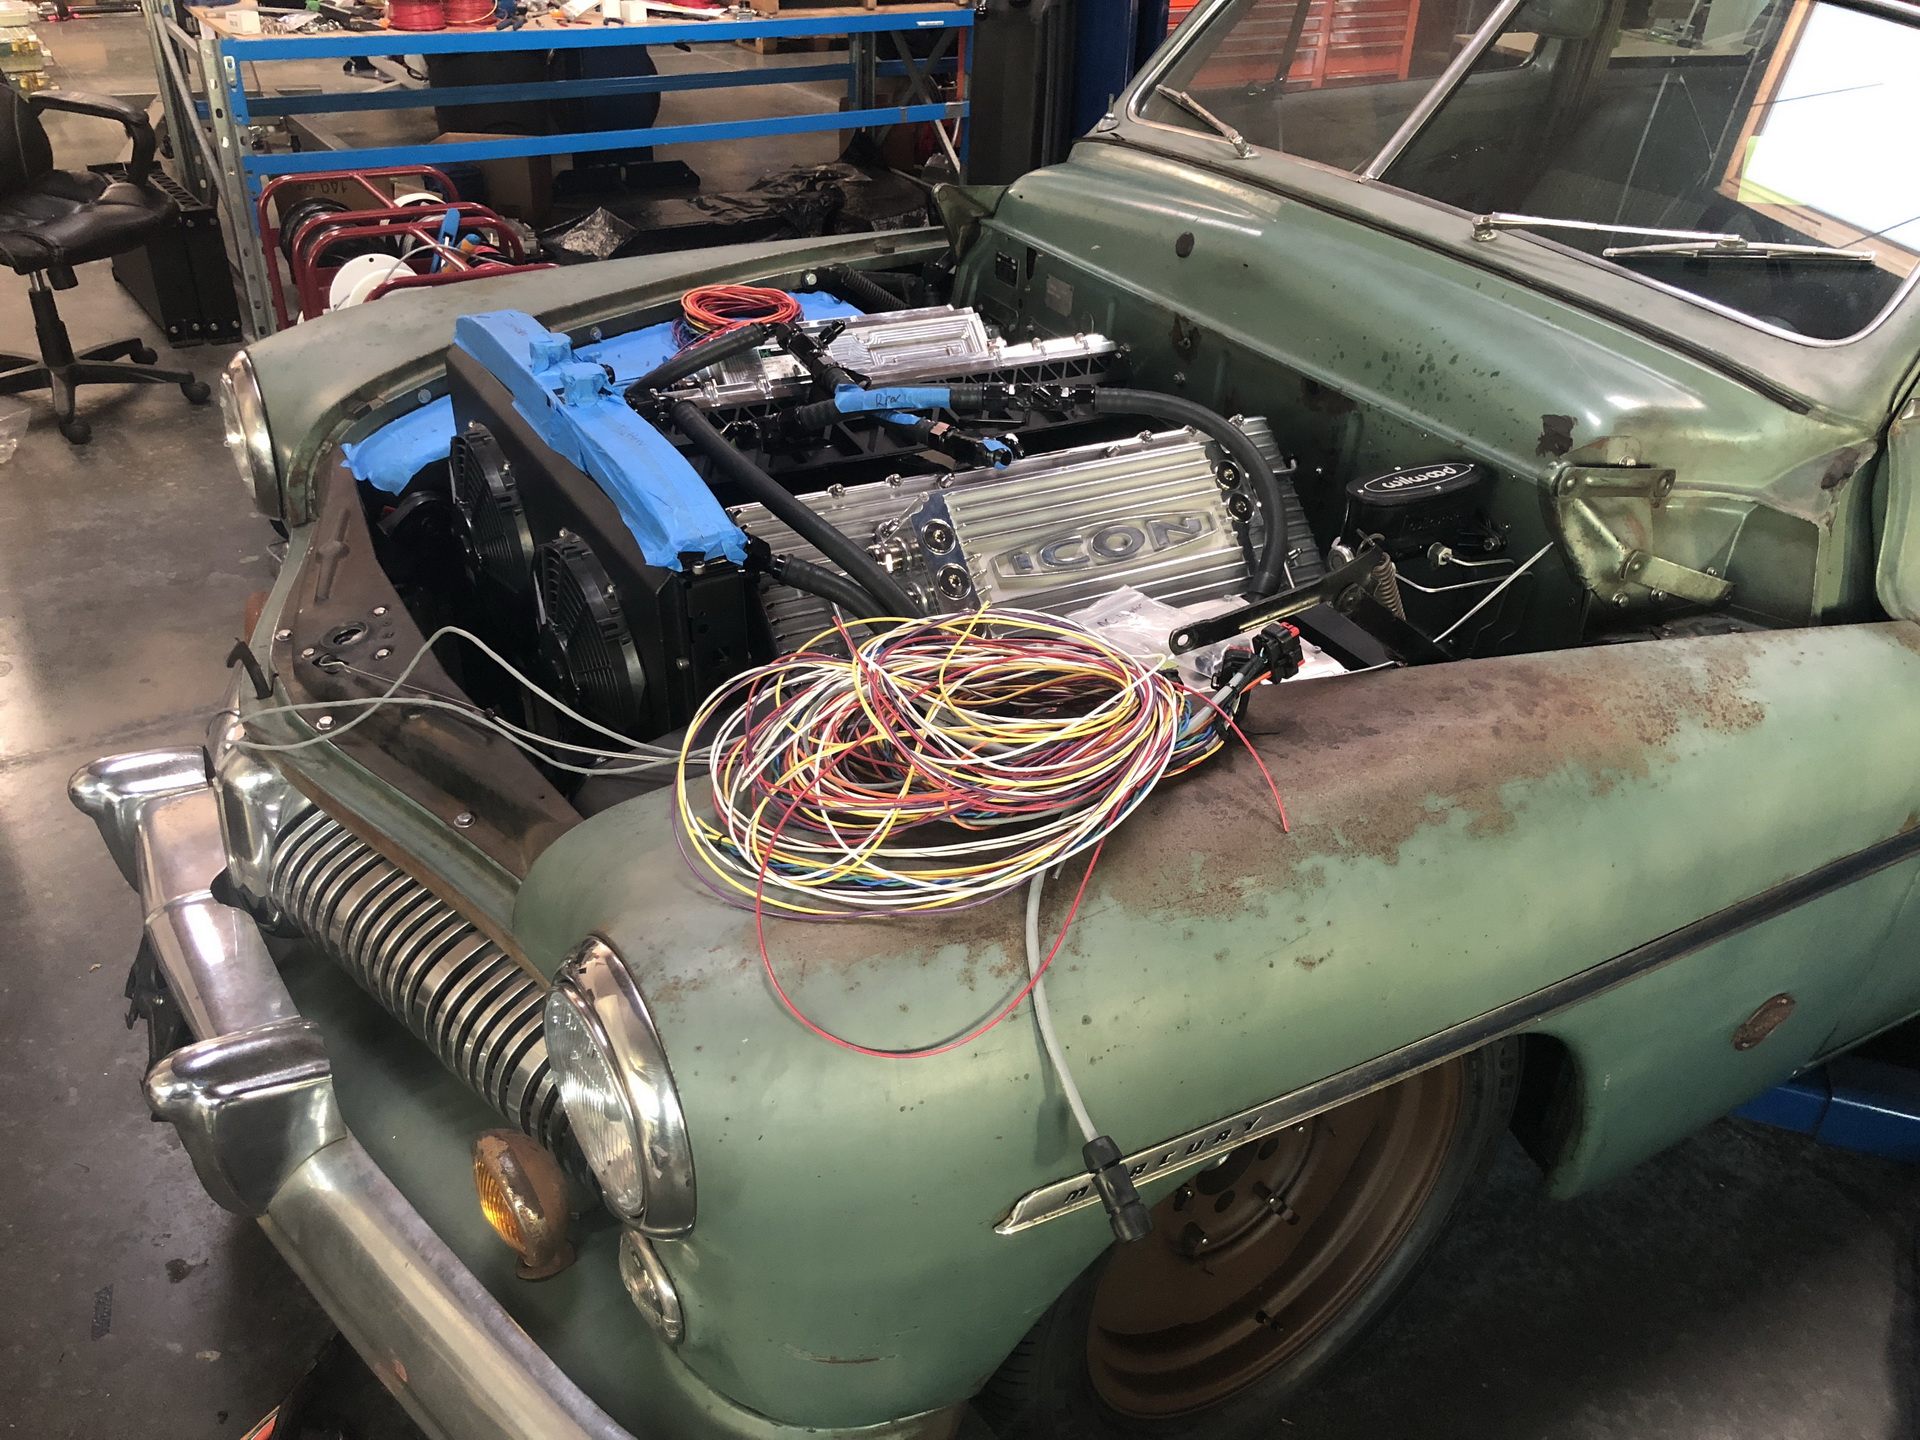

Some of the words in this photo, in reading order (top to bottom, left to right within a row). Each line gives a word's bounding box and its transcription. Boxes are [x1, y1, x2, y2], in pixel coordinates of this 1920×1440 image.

[1381, 465, 1457, 489] wilwood
[1012, 517, 1203, 576] ICON
[1064, 1115, 1263, 1204] MRCURY
